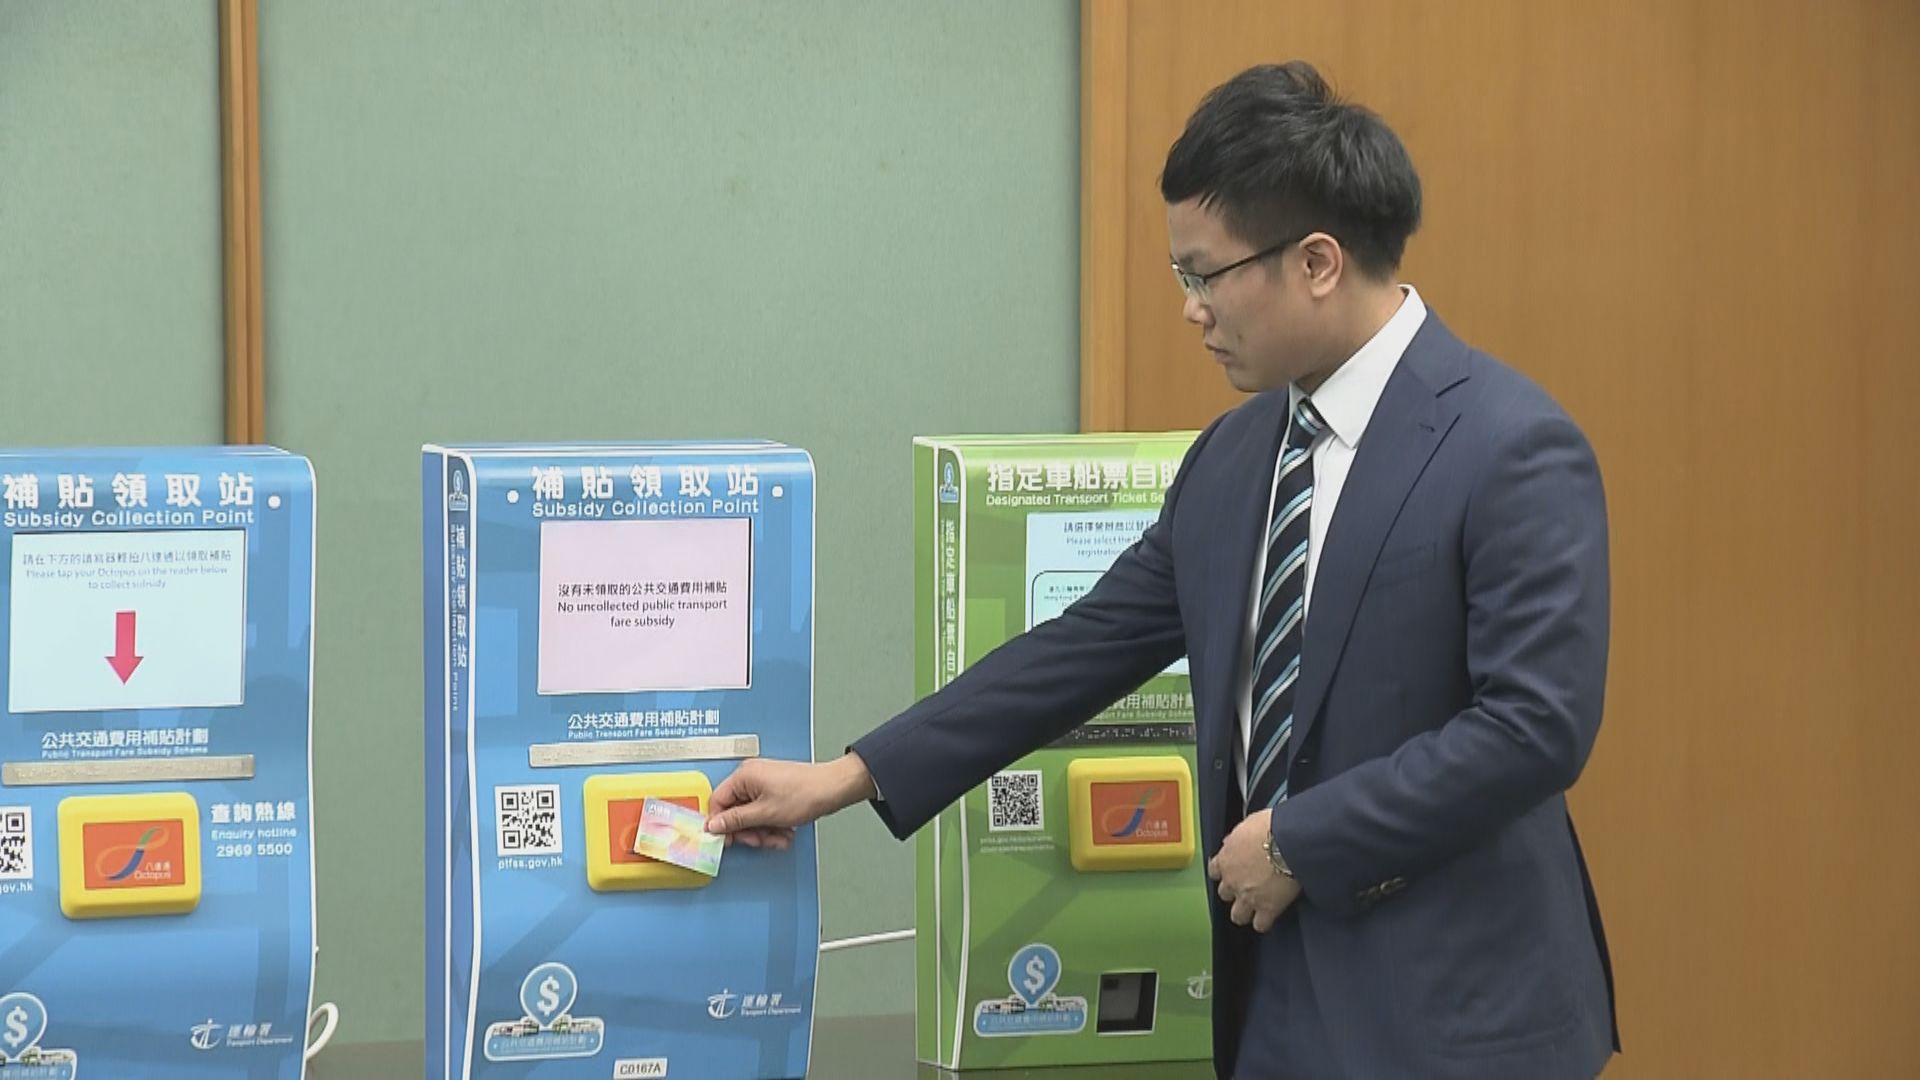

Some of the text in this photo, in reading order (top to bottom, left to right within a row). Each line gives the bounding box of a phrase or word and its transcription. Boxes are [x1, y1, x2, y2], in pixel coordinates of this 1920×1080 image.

[531, 465, 759, 499] 補貼領取站
[2, 472, 254, 509] 補貼領取站
[986, 494, 1051, 507] Designated
[1053, 493, 1108, 506] Transport
[1112, 492, 1147, 503] Ticket
[532, 498, 759, 518] Subsidy Collection Point
[4, 509, 254, 528] Subsidy Collection Point
[558, 581, 727, 597] 沒有未領取的公共交通費用補貼
[557, 599, 728, 613] No uncollected public transport
[610, 614, 676, 628] fare subsidy
[568, 709, 720, 729] 公共交通費用補貼計劃
[41, 728, 208, 750] 公共交通費用補貼計劃
[211, 802, 297, 823] 查詢熱線
[211, 827, 297, 842] Enquiry hotline
[216, 844, 293, 857] 2969 5500
[498, 857, 563, 870] ptfss.gov.hk
[619, 1063, 661, 1075] C0167A
